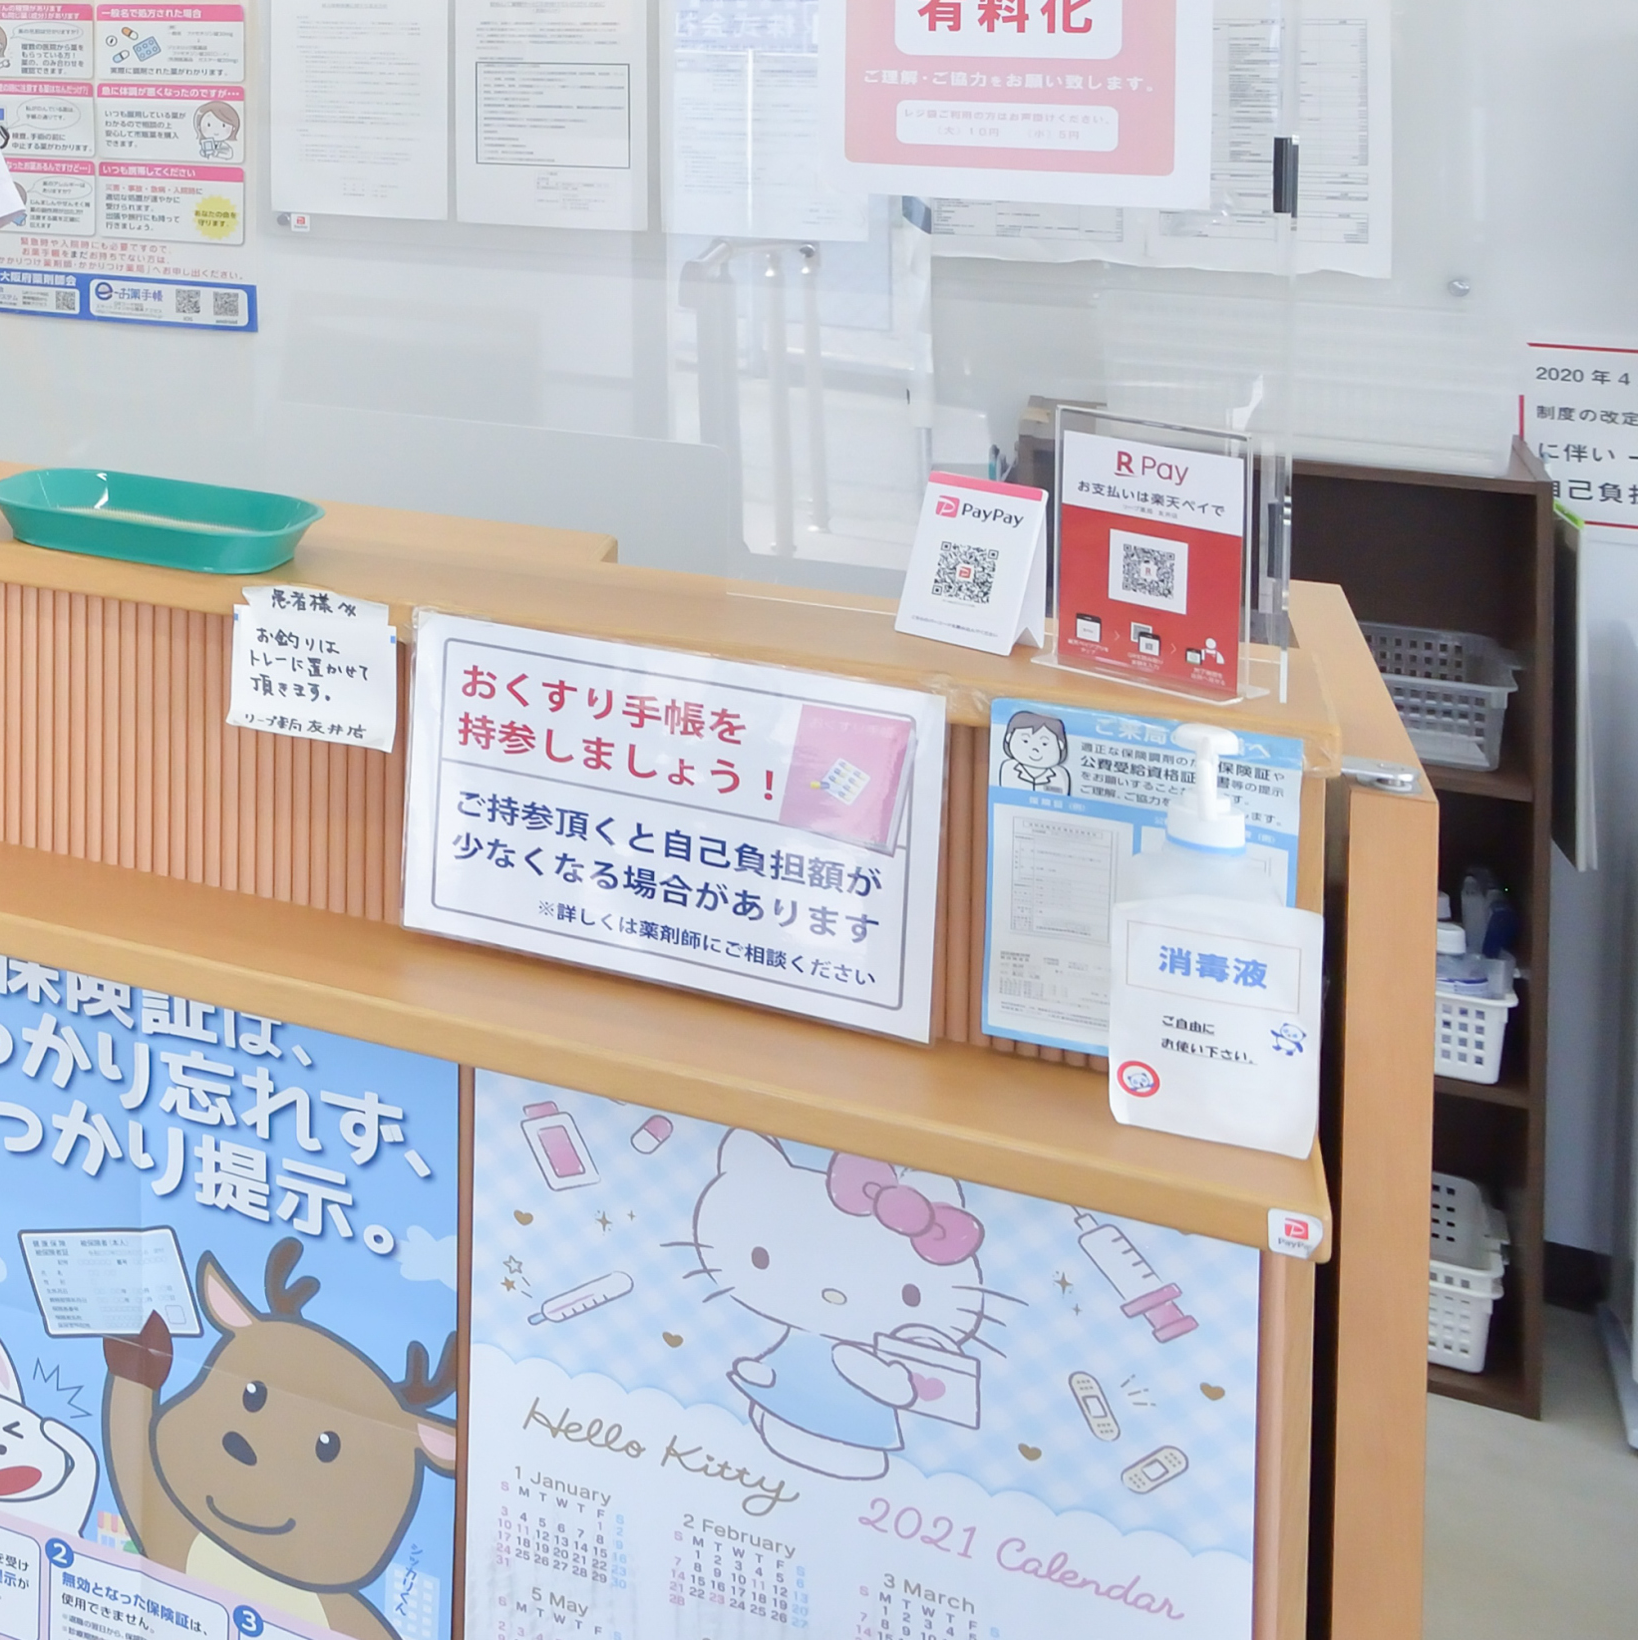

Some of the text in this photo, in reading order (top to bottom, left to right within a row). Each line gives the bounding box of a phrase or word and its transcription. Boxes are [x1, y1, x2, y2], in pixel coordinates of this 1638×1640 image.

[102, 9, 201, 19] 一般名で処方された場合
[864, 69, 1155, 92] ご理解・ご協力をお願い致します。
[105, 140, 138, 148] できます。
[103, 165, 196, 178] いつも携帯してください
[0, 271, 76, 286] 大阪府薬剤師会
[1536, 405, 1638, 426] 制度の改定
[1141, 456, 1189, 485] Pay
[1078, 480, 1225, 517] お支払いは楽天ペイで
[961, 503, 1024, 529] PayPay
[257, 628, 340, 654] お釣りは
[251, 650, 368, 681] トレーに置かせて
[251, 673, 331, 702] 頂きます。
[461, 665, 747, 745] おくすり手帳を
[306, 720, 366, 739] 友井店
[458, 712, 776, 802] 持参しましょう！
[457, 791, 882, 898] ご持参頂くと自己負担額が
[453, 832, 879, 944] 少なくなる場合があります
[539, 899, 876, 986] ※詳しくは薬剤師にご相談ください
[1159, 944, 1267, 991] 消毒液
[1162, 1014, 1215, 1035] ご自由に
[1161, 1037, 1257, 1064] お使い下さい。
[523, 1397, 800, 1516] Hello Kitty
[514, 1465, 612, 1506] 1 January
[684, 1514, 796, 1558] 2 February
[51, 1544, 68, 1563] 2
[858, 1497, 977, 1559] 2021
[997, 1537, 1185, 1620] Calendar
[393, 1542, 424, 1616] シッカリくん
[882, 1573, 896, 1589] 3
[904, 1579, 975, 1615] March
[62, 1572, 207, 1636] 無効となった保険証は、
[62, 1593, 154, 1633] 使用できません。
[532, 1587, 588, 1617] 5 May
[242, 1610, 256, 1631] 3
